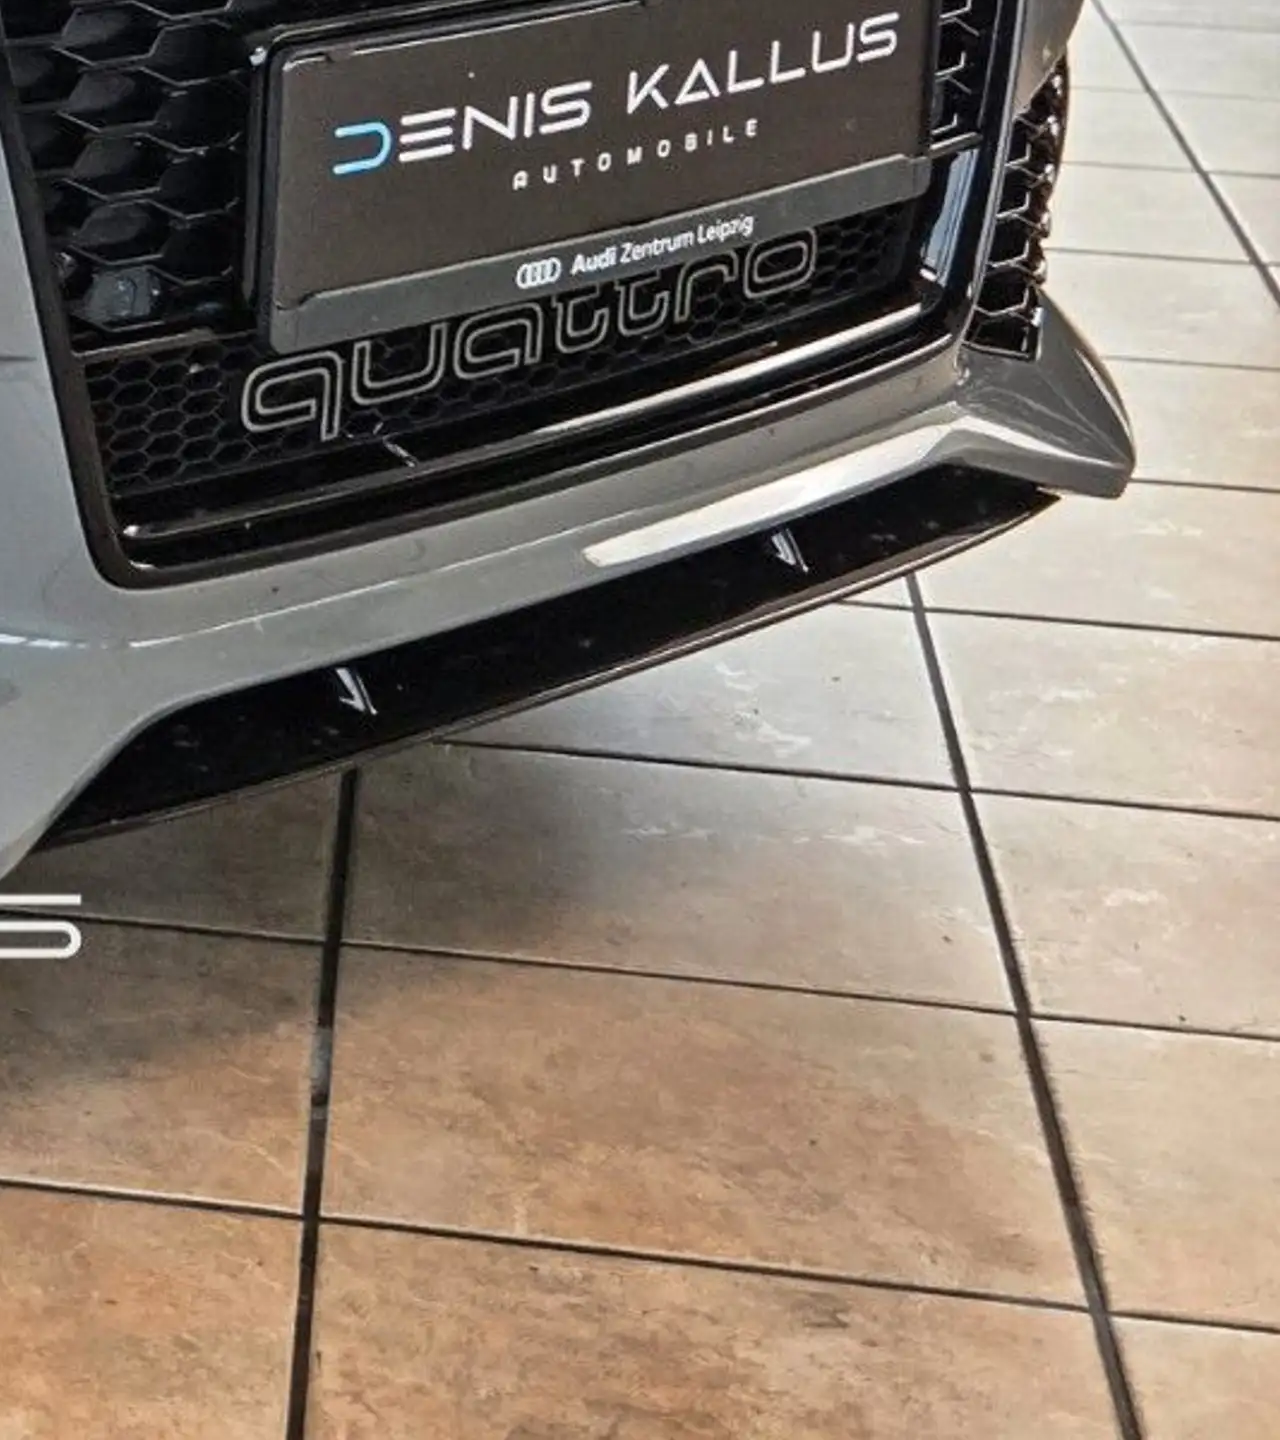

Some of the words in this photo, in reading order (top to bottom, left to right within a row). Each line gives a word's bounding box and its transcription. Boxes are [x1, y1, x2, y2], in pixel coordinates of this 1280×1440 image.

[332, 79, 593, 175] DENIS
[625, 11, 900, 115] KALLUS
[512, 117, 759, 191] AUTOMOBILE
[570, 244, 617, 275] Audi
[619, 230, 695, 264] Zentrum
[697, 213, 755, 245] Leipzig
[240, 227, 817, 441] quattro
